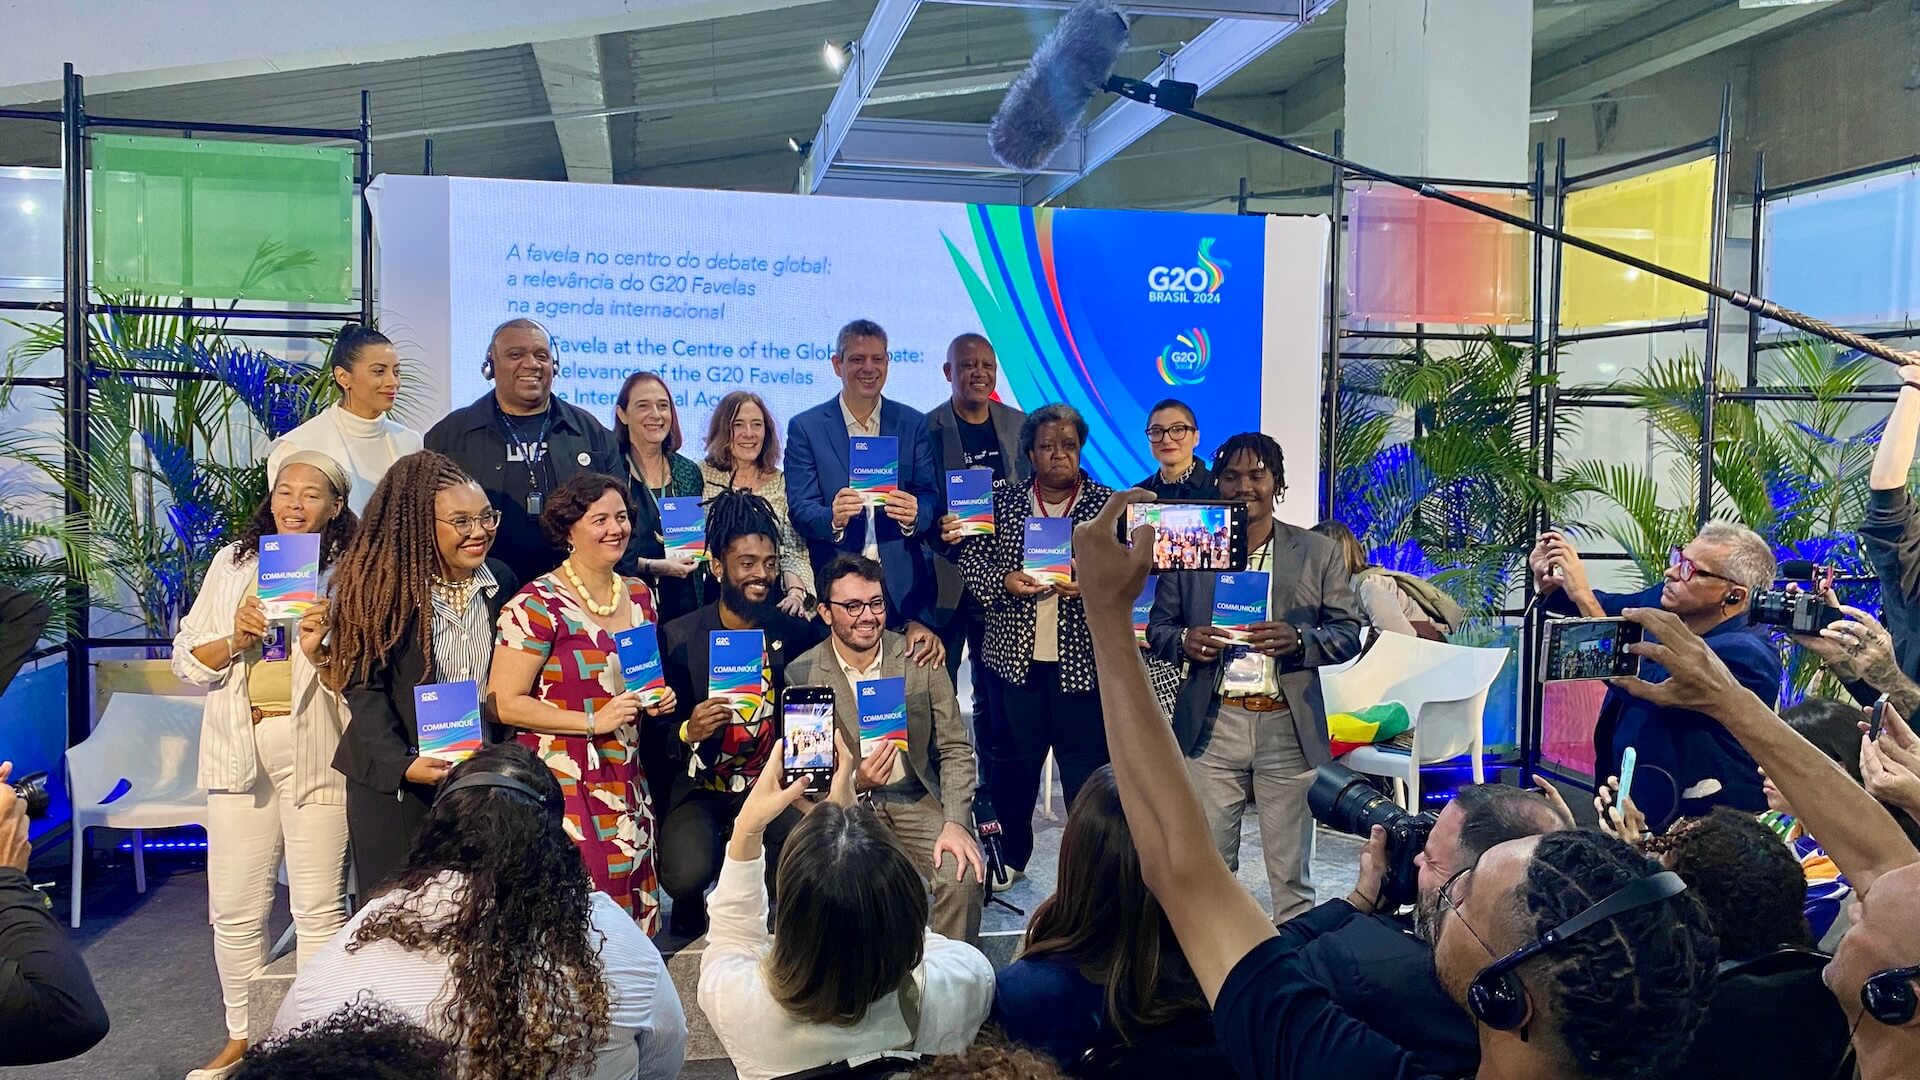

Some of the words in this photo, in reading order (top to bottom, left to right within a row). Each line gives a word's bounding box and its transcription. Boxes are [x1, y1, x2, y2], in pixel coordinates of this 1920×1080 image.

[506, 243, 521, 261] A
[527, 243, 580, 263] favela
[586, 251, 609, 265] no
[614, 252, 671, 267] centro
[676, 250, 700, 269] do
[706, 251, 768, 272] debate
[773, 253, 832, 277] global:
[507, 273, 517, 287] a
[524, 269, 614, 290] relevância
[620, 272, 645, 292] do
[650, 275, 687, 293] G20
[692, 277, 757, 296] Favelas
[1148, 265, 1209, 293] G20
[1149, 291, 1190, 303] BRASIL
[1193, 292, 1221, 304] 2024
[507, 300, 530, 314] na
[535, 297, 605, 318] agenda
[610, 299, 725, 320] internacional
[614, 340, 631, 355] at
[637, 338, 667, 356] the
[672, 339, 733, 357] Centre
[739, 341, 757, 358] of
[761, 342, 790, 359] the
[796, 343, 834, 360] Glob
[1171, 351, 1197, 363] G20
[671, 364, 701, 382] the
[707, 366, 744, 383] G20
[750, 368, 814, 385] Favelas
[261, 570, 311, 580] COMMUNIQUÉ
[1217, 602, 1262, 613] COMMUNIQUÉ
[713, 664, 758, 673] COMMUNIQUÉ
[422, 718, 474, 731] COMMUNIQUÉ
